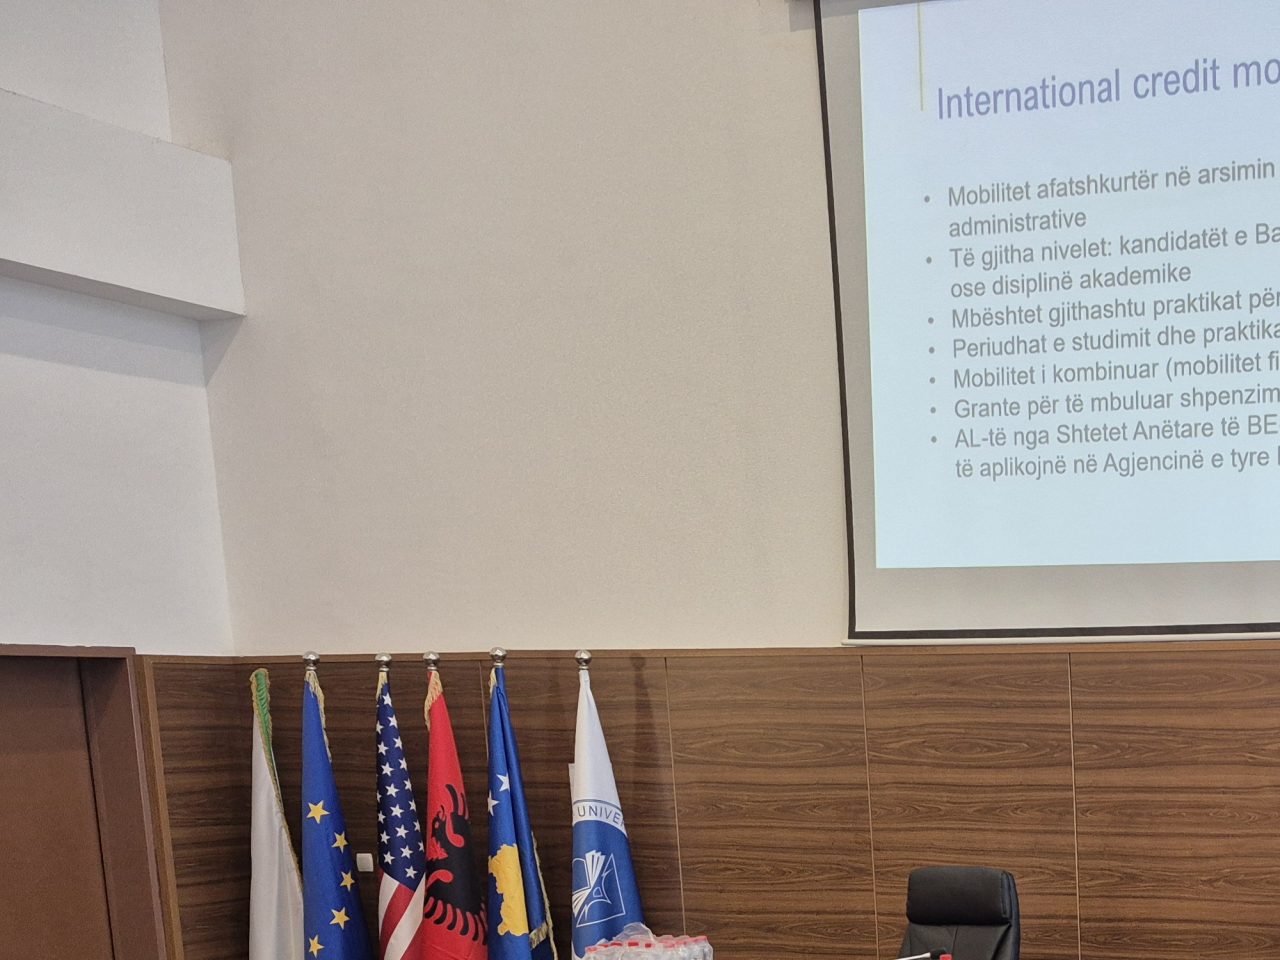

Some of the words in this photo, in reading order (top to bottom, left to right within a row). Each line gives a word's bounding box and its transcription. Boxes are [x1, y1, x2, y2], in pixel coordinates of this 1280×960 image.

[937, 67, 1121, 121] International
[1133, 57, 1221, 100] credit
[948, 180, 1032, 208] Mobilitet
[1036, 168, 1160, 200] afatshkurtër
[1165, 165, 1192, 189] në
[1197, 157, 1276, 185] arsimin
[948, 207, 1087, 238] administrative
[951, 247, 976, 269] Të
[981, 243, 1035, 272] gjitha
[1041, 236, 1112, 262] nivelet:
[1119, 226, 1229, 257] kandidatët
[1234, 229, 1248, 247] e
[950, 280, 987, 299] ose
[991, 269, 1073, 299] disiplinë
[1079, 262, 1192, 290] akademike
[951, 303, 1044, 329] Mbështet
[1048, 297, 1146, 328] gjithashtu
[1153, 289, 1243, 322] praktikat
[952, 333, 1048, 359] Periudhat
[1052, 335, 1066, 353] e
[1071, 326, 1152, 352] studimit
[1156, 324, 1196, 347] dhe
[953, 365, 1036, 390] Mobilitet
[1041, 363, 1046, 385] i
[1052, 359, 1160, 385] kombinuar
[1165, 349, 1262, 383] (mobilitet
[954, 397, 1021, 419] Grante
[1027, 394, 1060, 422] për
[1064, 393, 1084, 414] të
[1090, 389, 1175, 413] mbuluar
[954, 426, 1007, 449] AL-të
[1013, 426, 1050, 451] nga
[1056, 421, 1129, 444] Shtetet
[1132, 416, 1214, 441] Anëtare
[1220, 415, 1241, 438] të
[954, 458, 974, 479] të
[979, 454, 1067, 483] aplikojnë
[1073, 453, 1098, 475] në
[1102, 448, 1205, 478] Agjencinë
[1210, 452, 1225, 469] e
[1229, 447, 1271, 473] tyre
